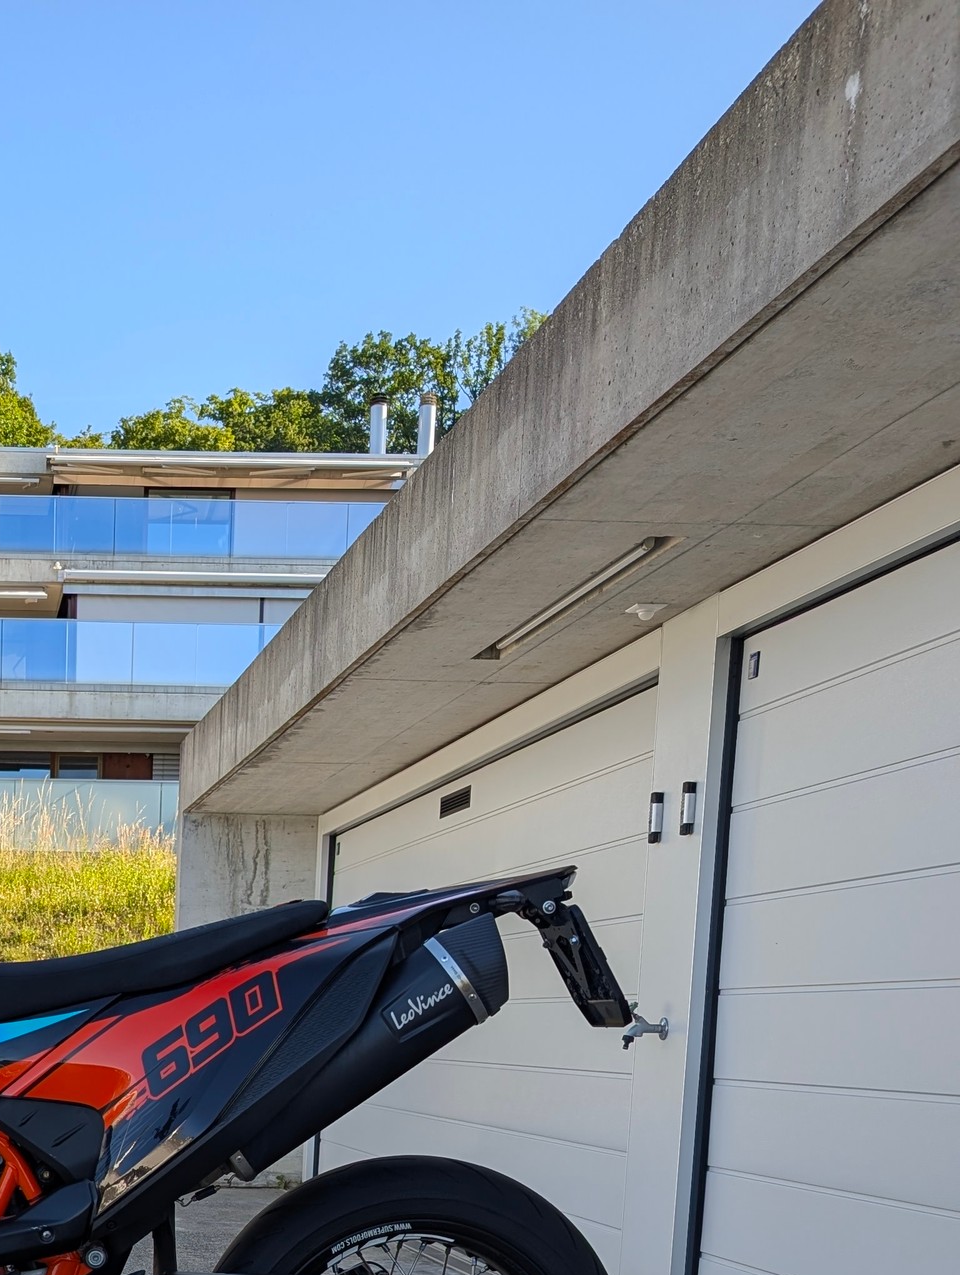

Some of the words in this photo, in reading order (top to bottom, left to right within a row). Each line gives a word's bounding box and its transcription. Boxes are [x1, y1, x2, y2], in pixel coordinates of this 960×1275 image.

[390, 983, 454, 1030] LeoVince
[141, 969, 283, 1100] 690
[330, 1222, 412, 1254] WWW.SUPERMOFOOLS.COM
